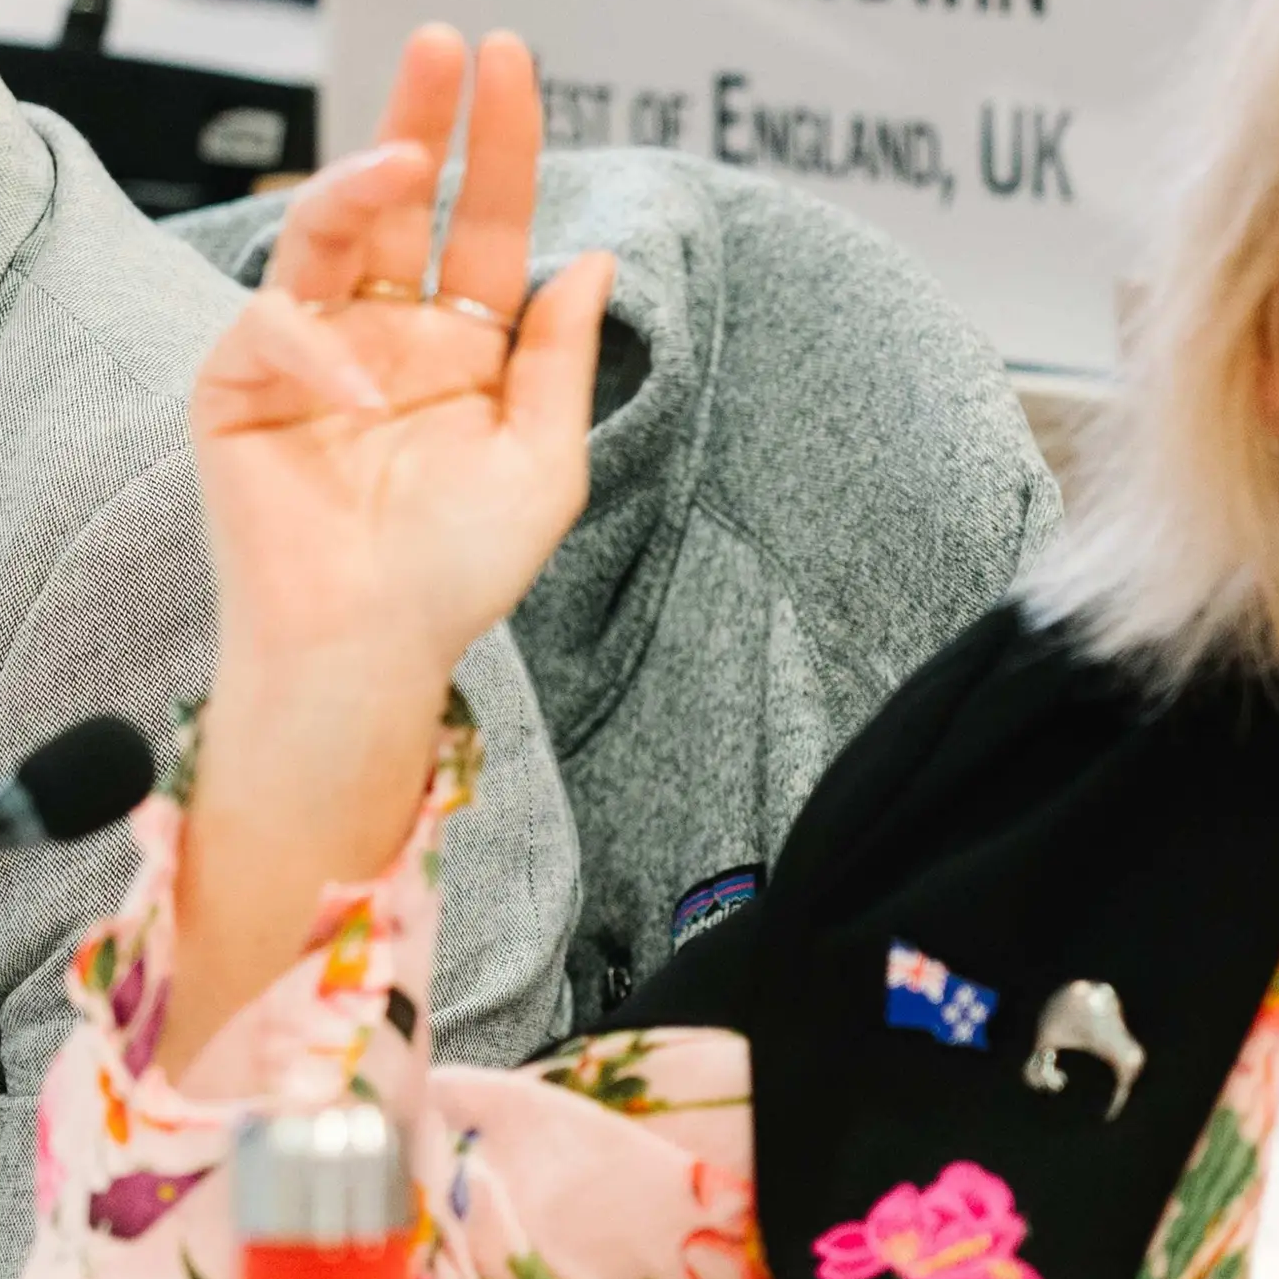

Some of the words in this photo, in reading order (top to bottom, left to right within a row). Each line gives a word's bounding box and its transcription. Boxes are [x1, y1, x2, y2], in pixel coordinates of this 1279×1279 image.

[533, 55, 611, 149] EST
[712, 71, 954, 206] ENGLAND,
[981, 100, 1074, 200] UK
